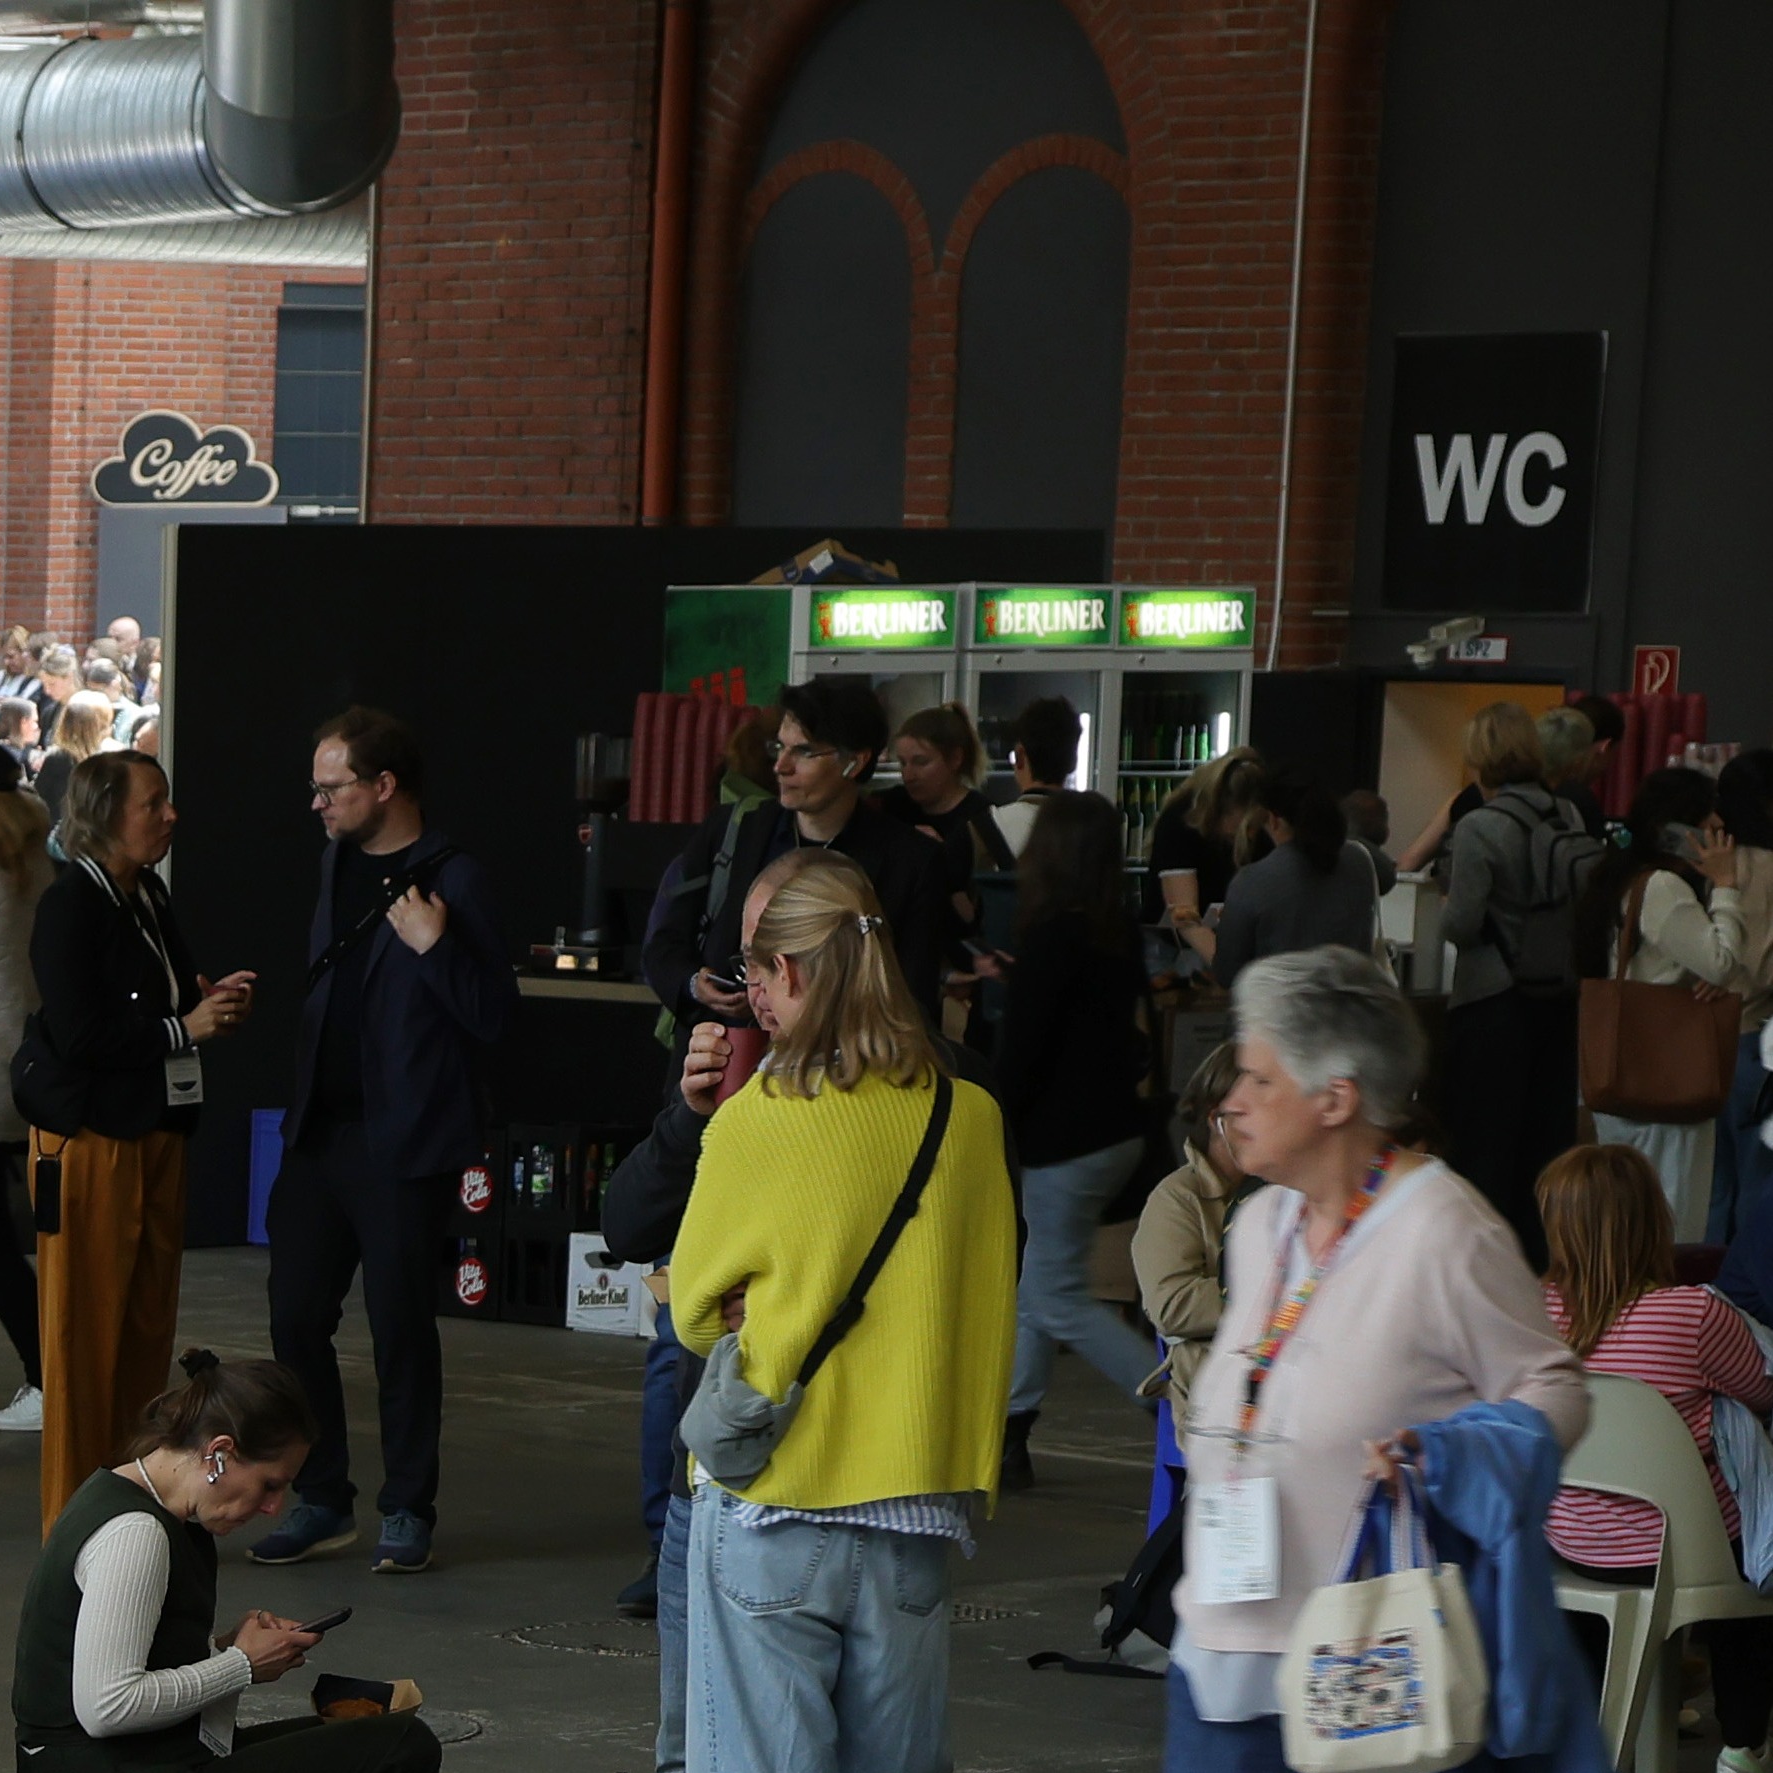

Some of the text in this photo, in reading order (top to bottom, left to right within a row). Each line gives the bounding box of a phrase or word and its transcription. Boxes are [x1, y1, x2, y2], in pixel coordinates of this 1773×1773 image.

[130, 438, 239, 500] Coffee
[1414, 431, 1568, 527] WC
[832, 598, 948, 640] BERLINER
[997, 598, 1106, 638] BERLINER
[1140, 599, 1245, 639] BERLINER
[462, 1171, 488, 1189] Vita
[463, 1185, 490, 1204] Cola
[458, 1264, 483, 1282] Vita
[458, 1278, 485, 1297] Cola
[578, 1287, 629, 1306] Berliner Kindl
